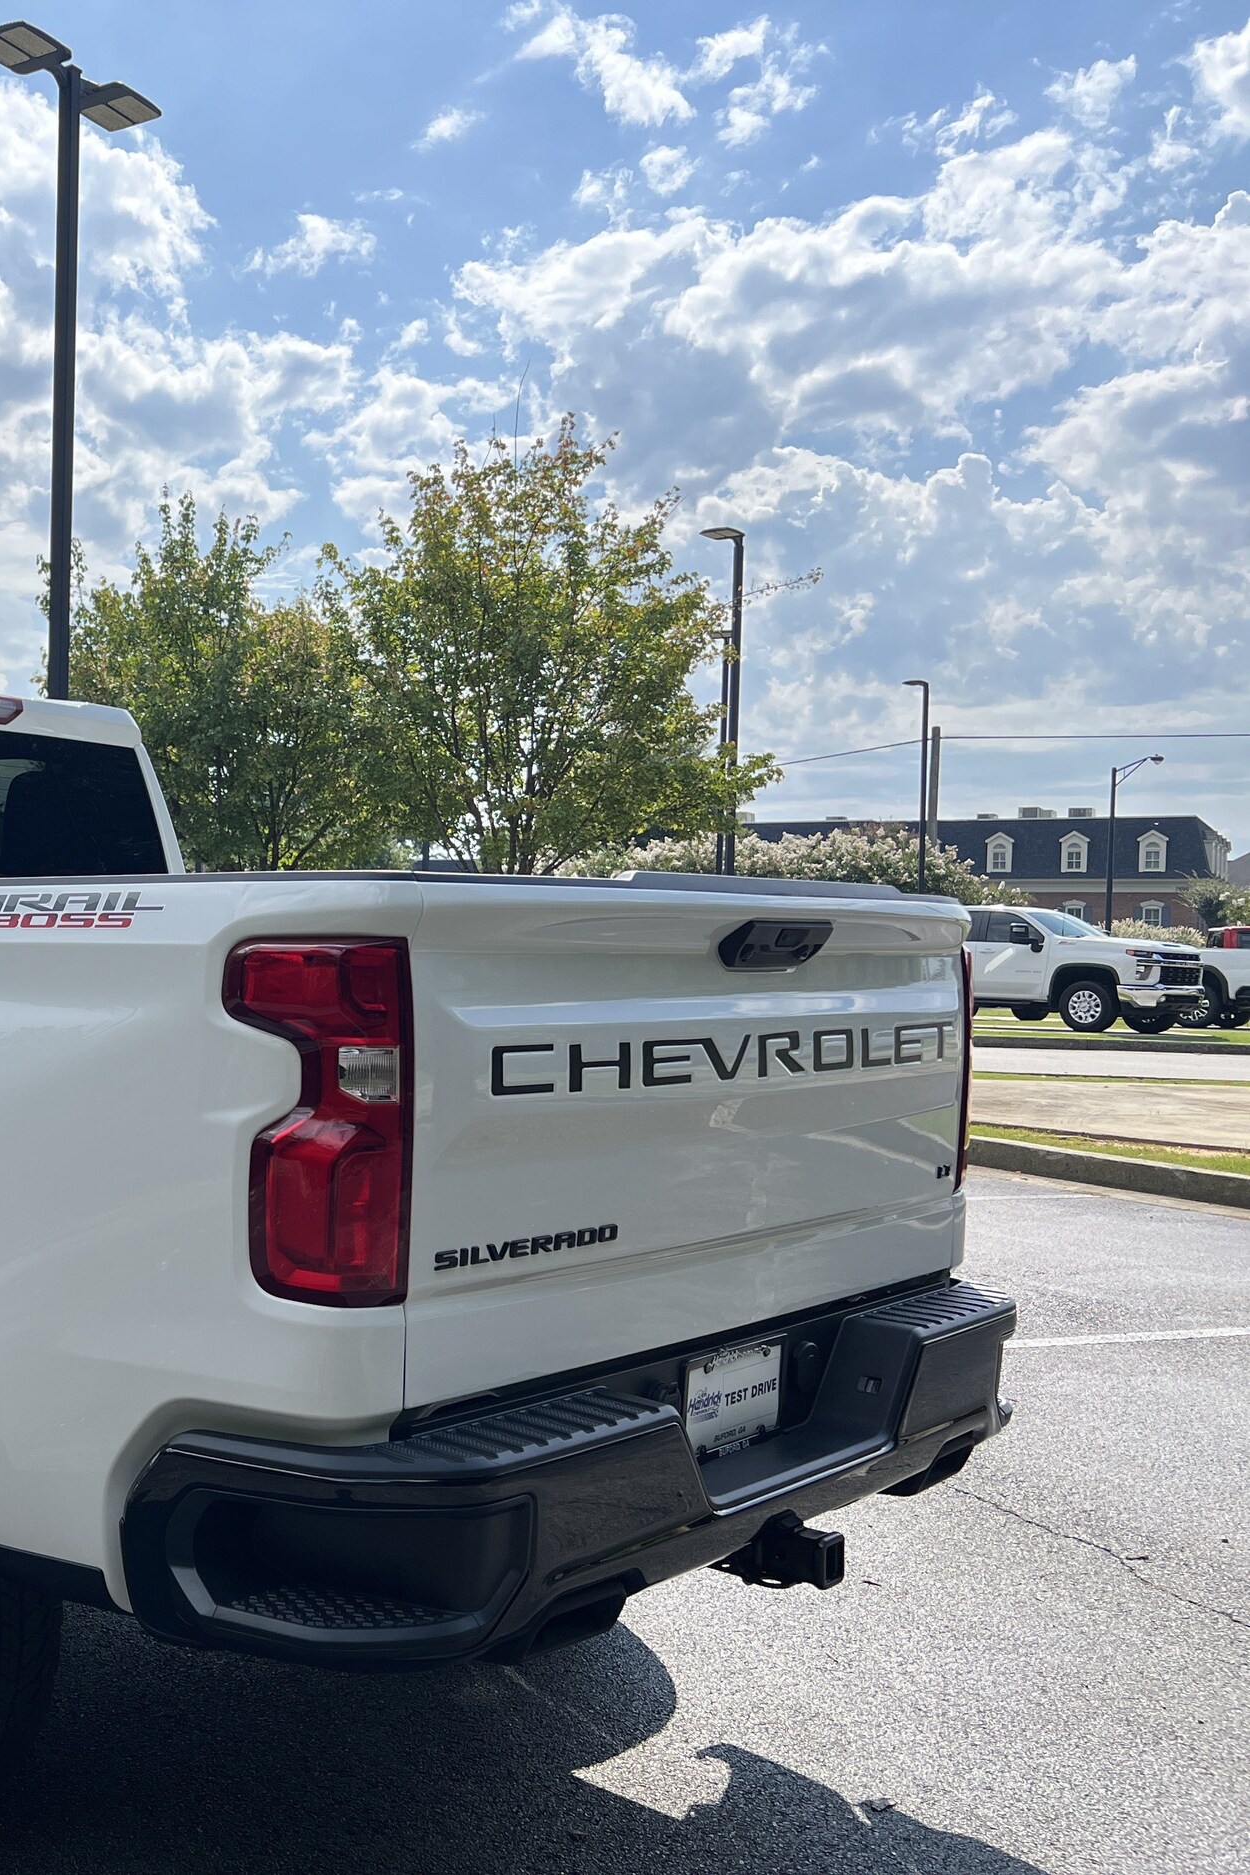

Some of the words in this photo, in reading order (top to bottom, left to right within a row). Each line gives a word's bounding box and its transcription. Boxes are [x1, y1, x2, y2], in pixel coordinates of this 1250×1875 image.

[491, 1021, 952, 1096] CHEVROLET
[433, 1223, 619, 1271] SILVERADO
[687, 1390, 722, 1416] Hendrick
[724, 1387, 749, 1407] TEST
[751, 1377, 777, 1399] DRIVE
